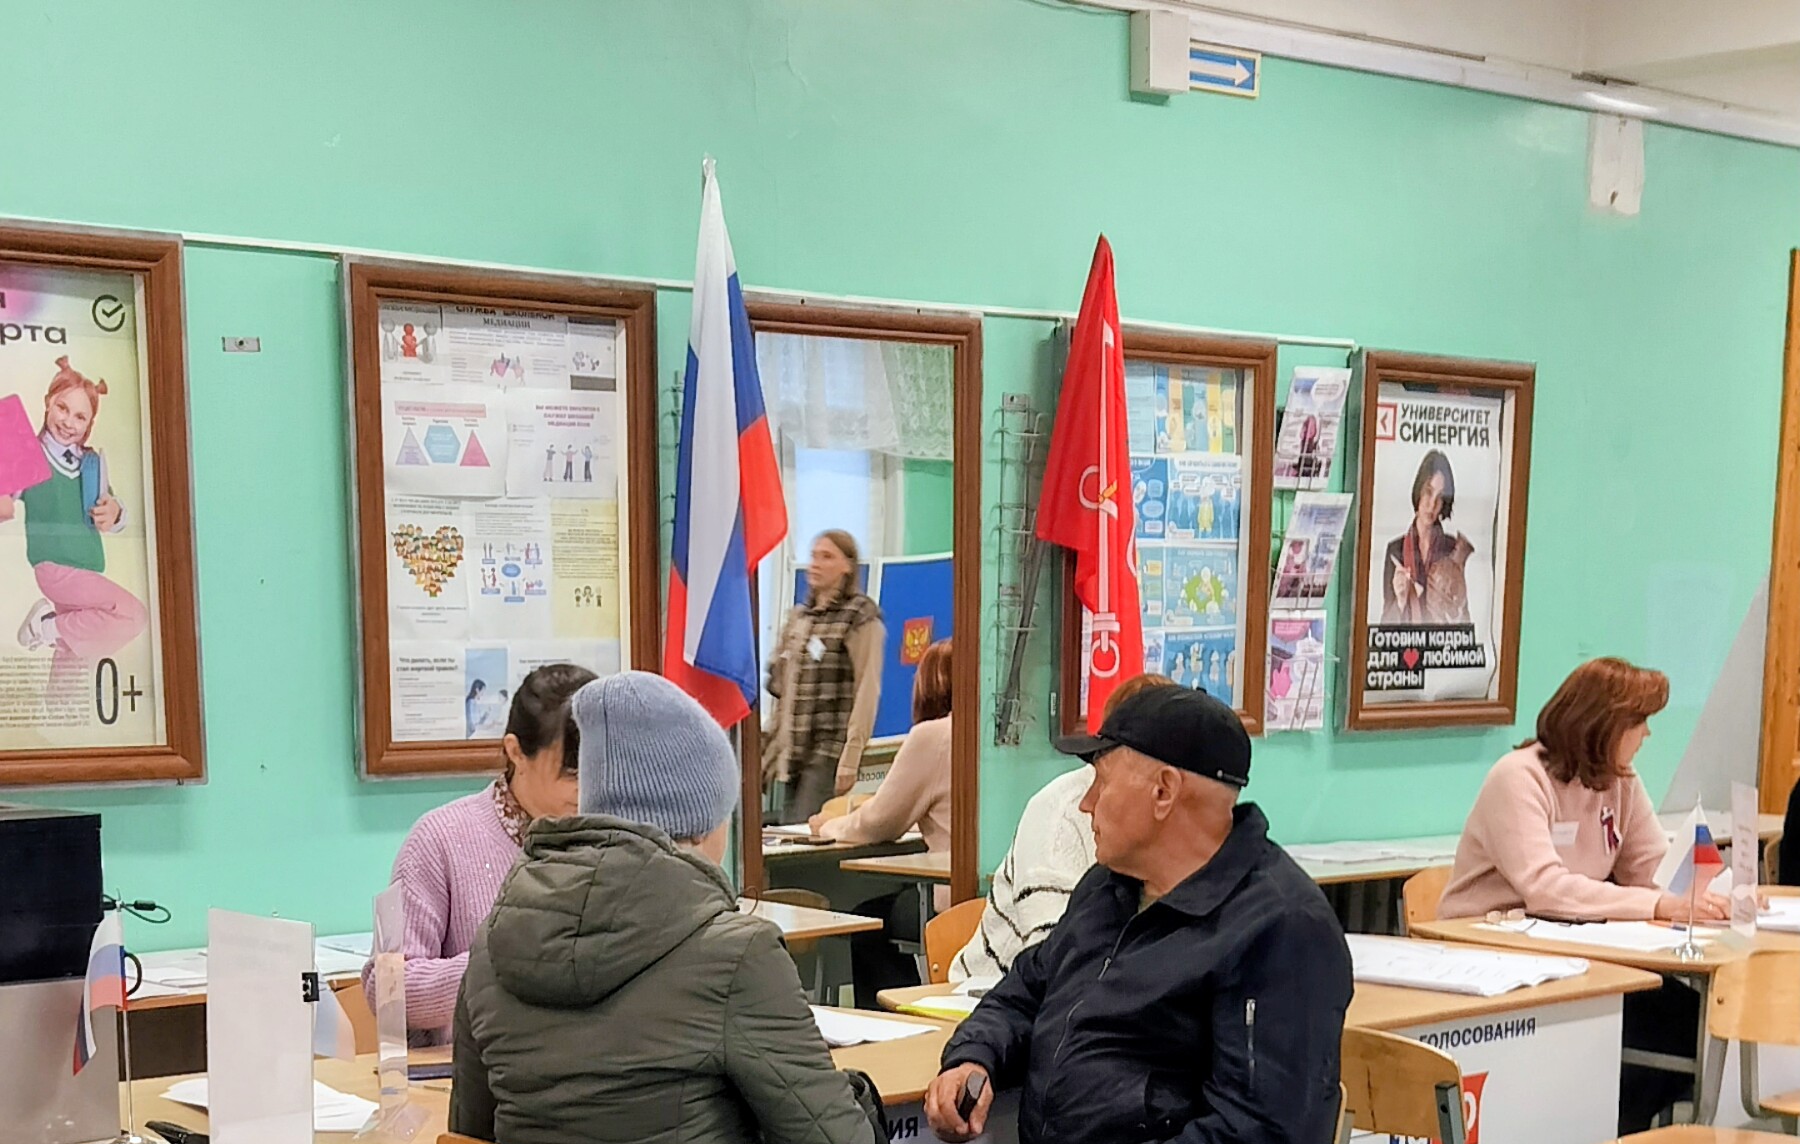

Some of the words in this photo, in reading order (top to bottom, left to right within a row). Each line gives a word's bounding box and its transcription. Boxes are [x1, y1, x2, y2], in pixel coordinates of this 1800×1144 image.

[1401, 403, 1490, 425] УНИВЕРСИТЕТ
[1400, 422, 1489, 448] СИНЕРГИЯ
[1369, 627, 1427, 648] Готовим
[1428, 630, 1473, 651] кадры
[1367, 651, 1399, 670] для
[1422, 644, 1484, 667] любимой
[95, 657, 143, 725] 0+
[1367, 670, 1423, 691] страны
